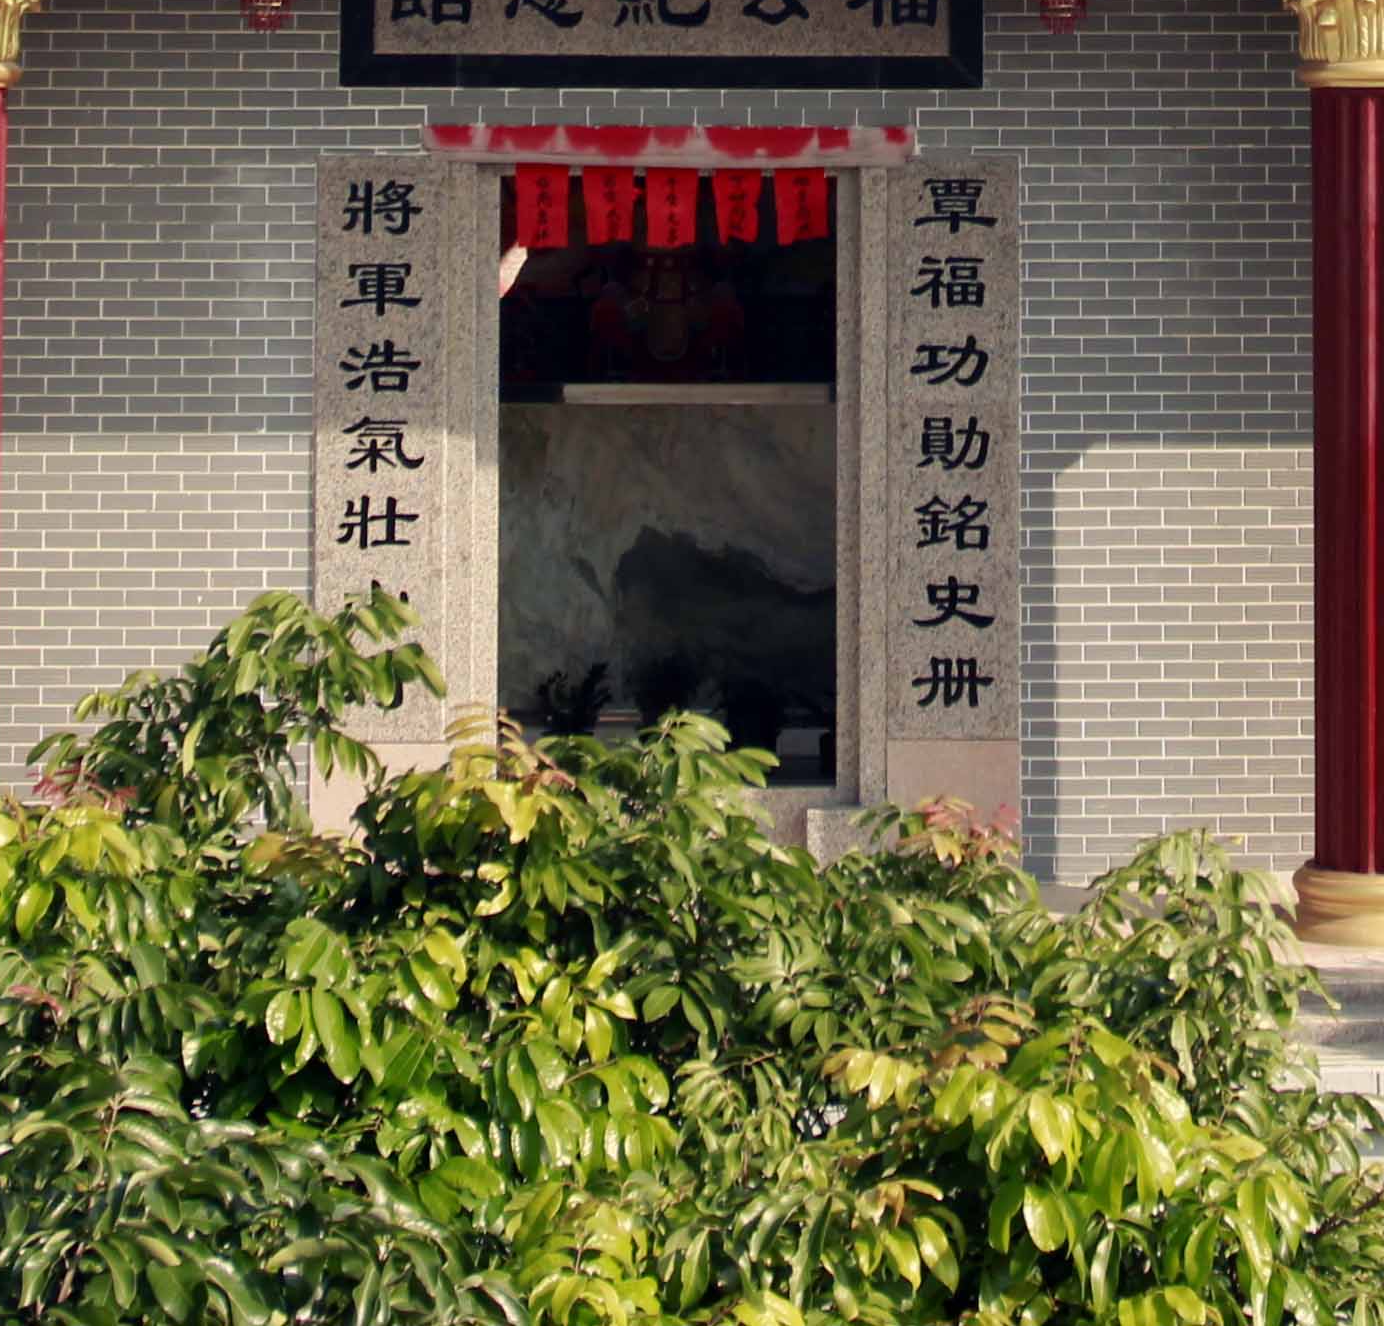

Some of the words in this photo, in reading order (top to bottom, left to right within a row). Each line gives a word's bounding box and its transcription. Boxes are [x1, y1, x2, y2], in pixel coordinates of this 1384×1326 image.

[335, 179, 427, 710] 將軍浩氣壯
